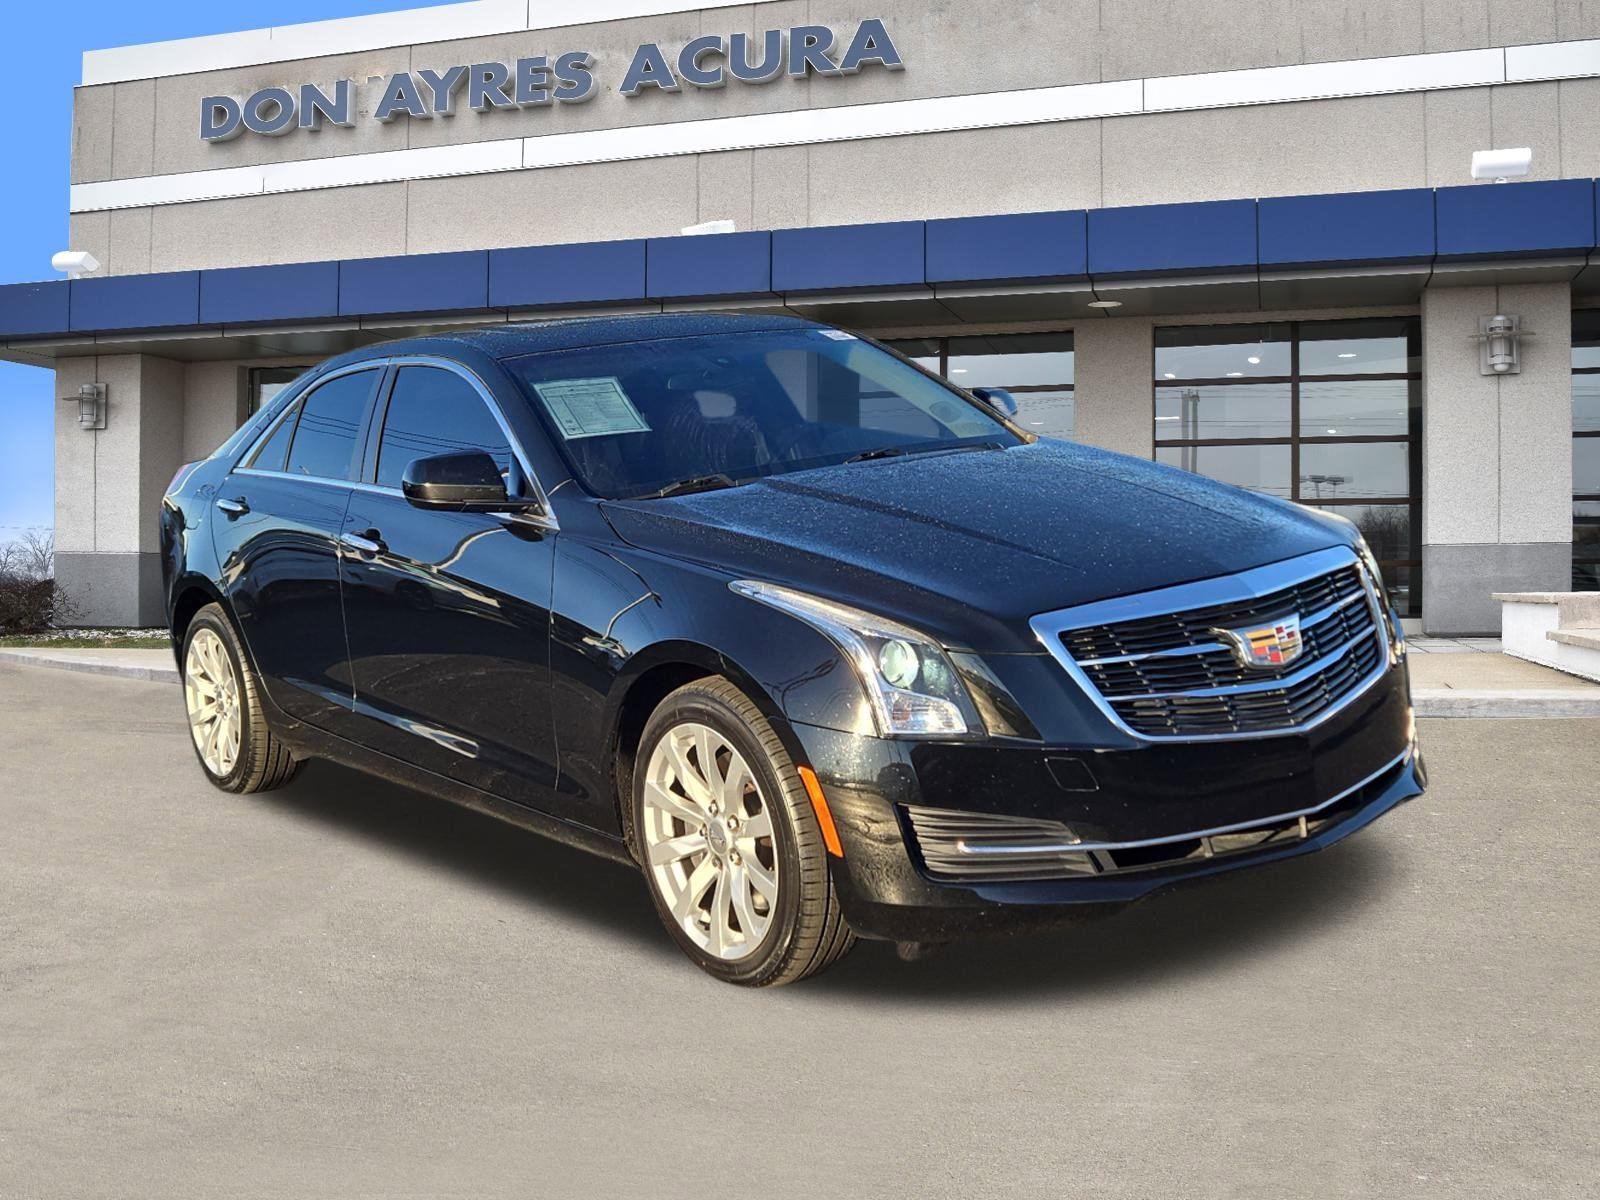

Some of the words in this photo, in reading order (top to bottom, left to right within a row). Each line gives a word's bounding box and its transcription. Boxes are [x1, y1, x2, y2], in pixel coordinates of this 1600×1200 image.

[200, 80, 354, 142] DON
[374, 50, 597, 122] AYRES
[619, 17, 905, 97] ACURA
